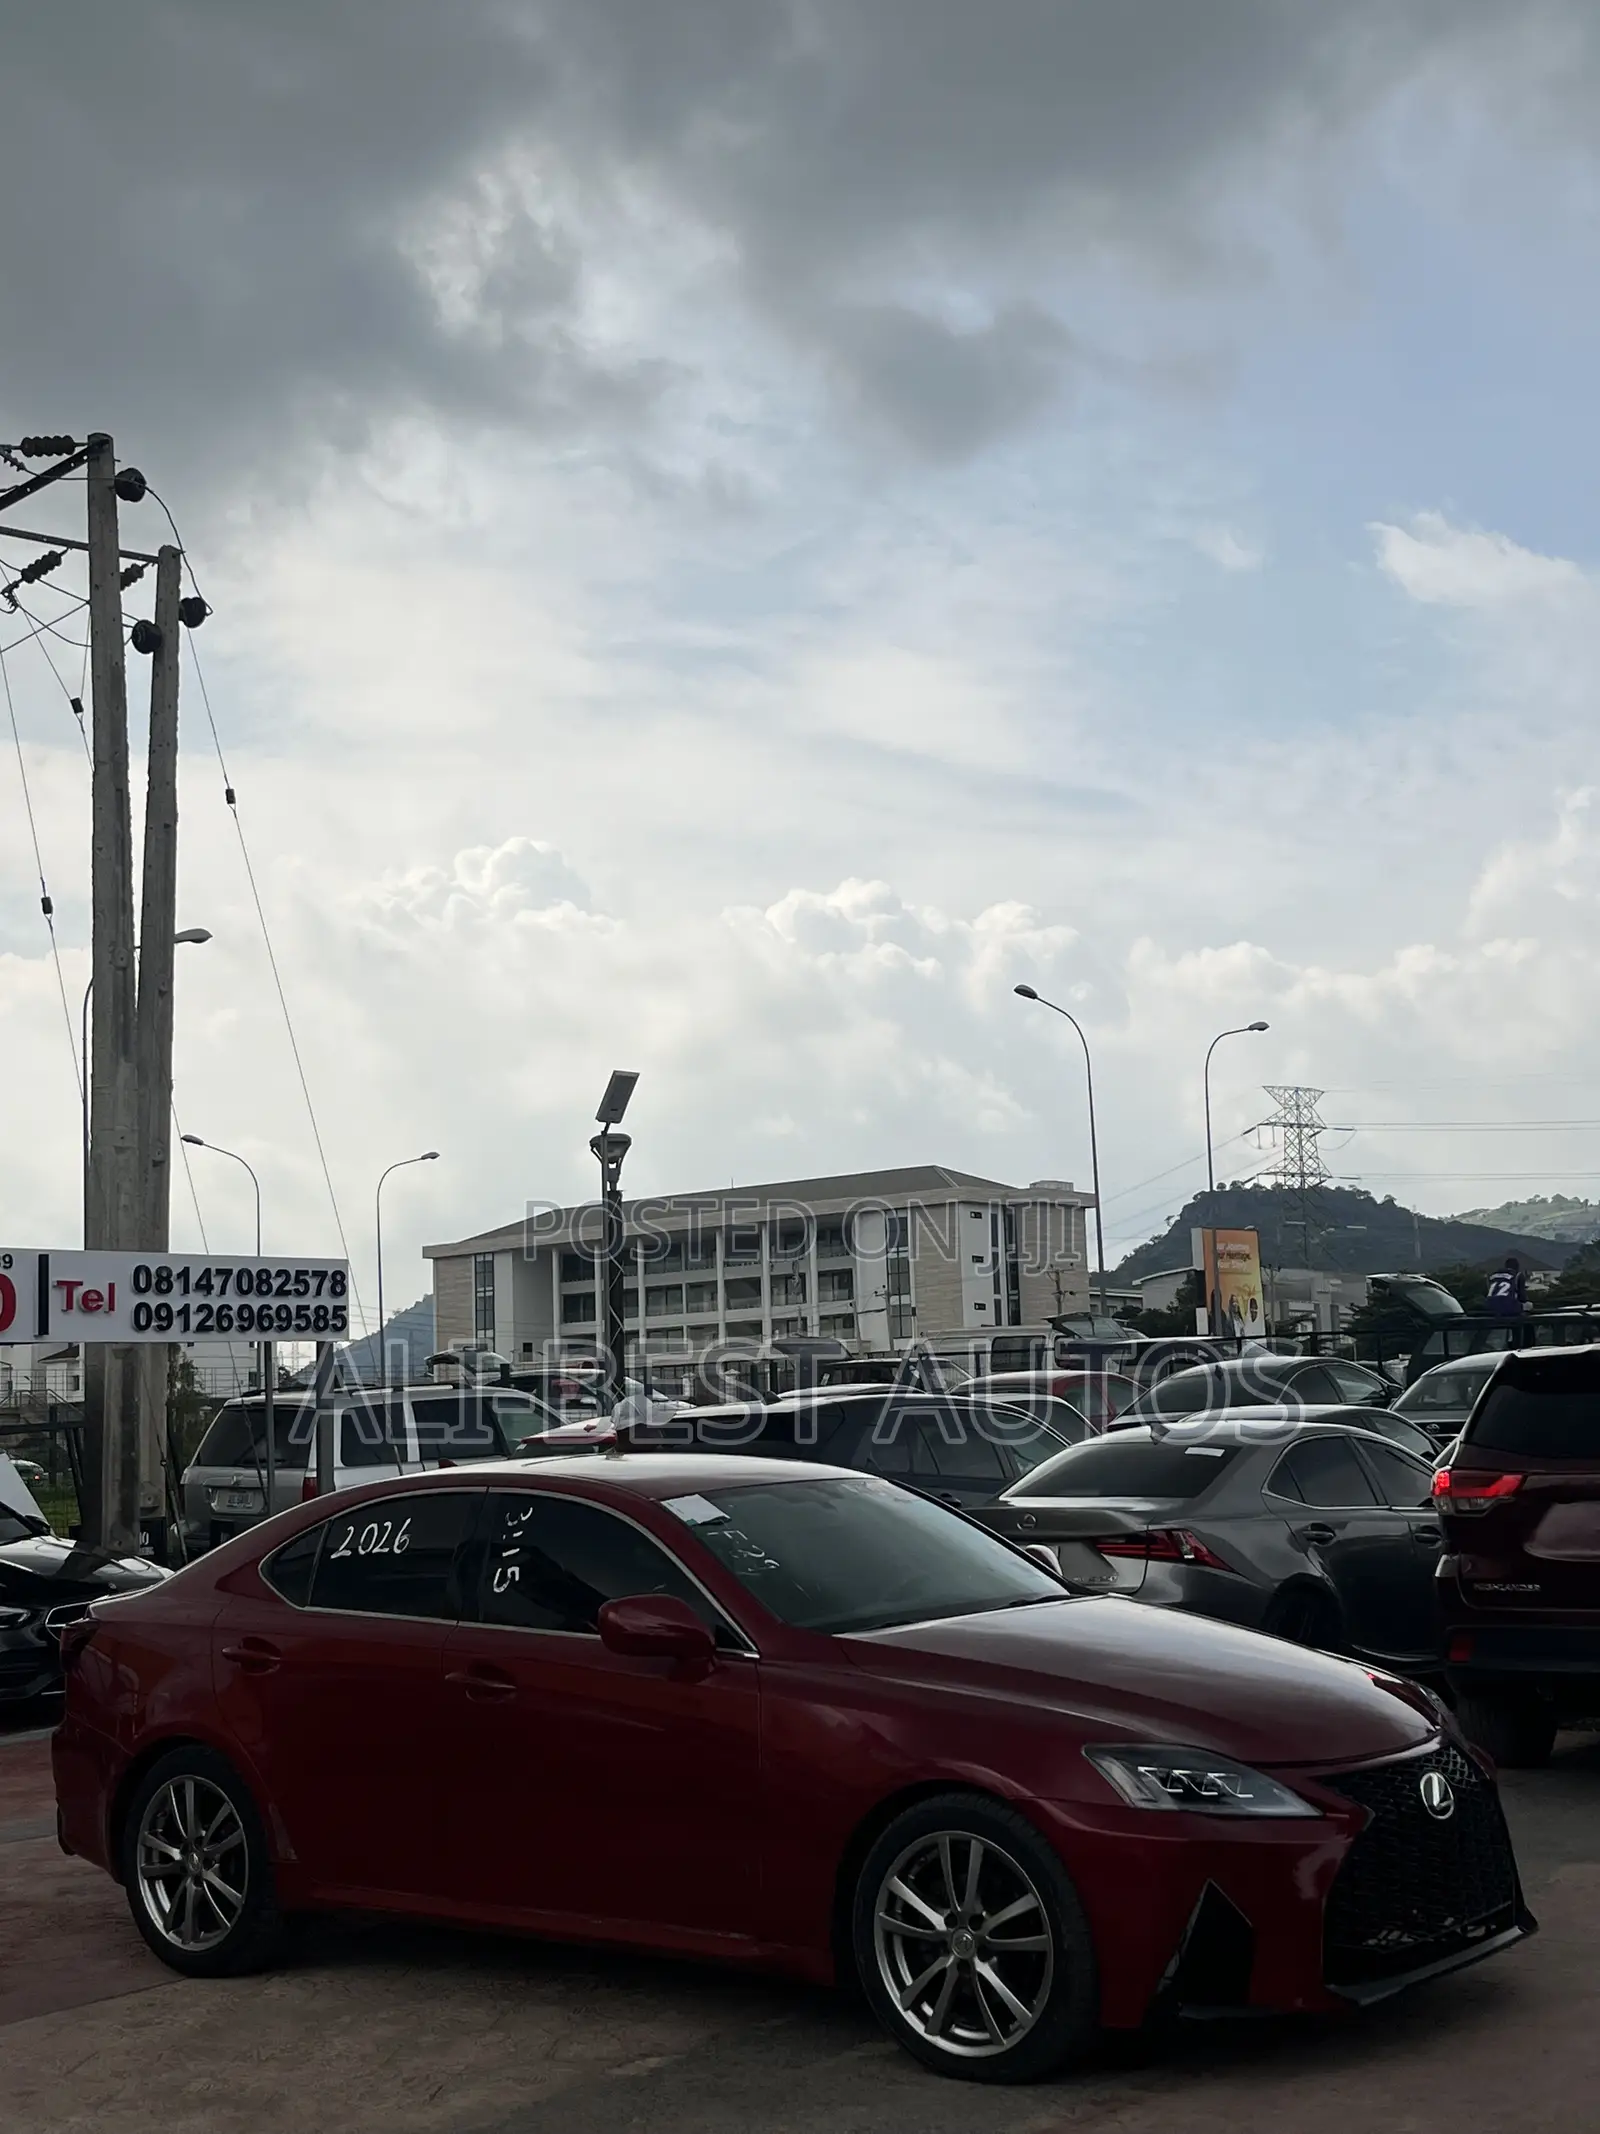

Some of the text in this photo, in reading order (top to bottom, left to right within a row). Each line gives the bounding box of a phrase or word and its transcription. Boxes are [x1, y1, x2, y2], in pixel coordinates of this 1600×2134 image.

[0, 1253, 13, 1269] 9
[54, 1280, 116, 1312] Tel
[131, 1264, 347, 1297] 08147082578
[131, 1301, 348, 1333] 09126969585
[330, 1517, 412, 1559] 2026
